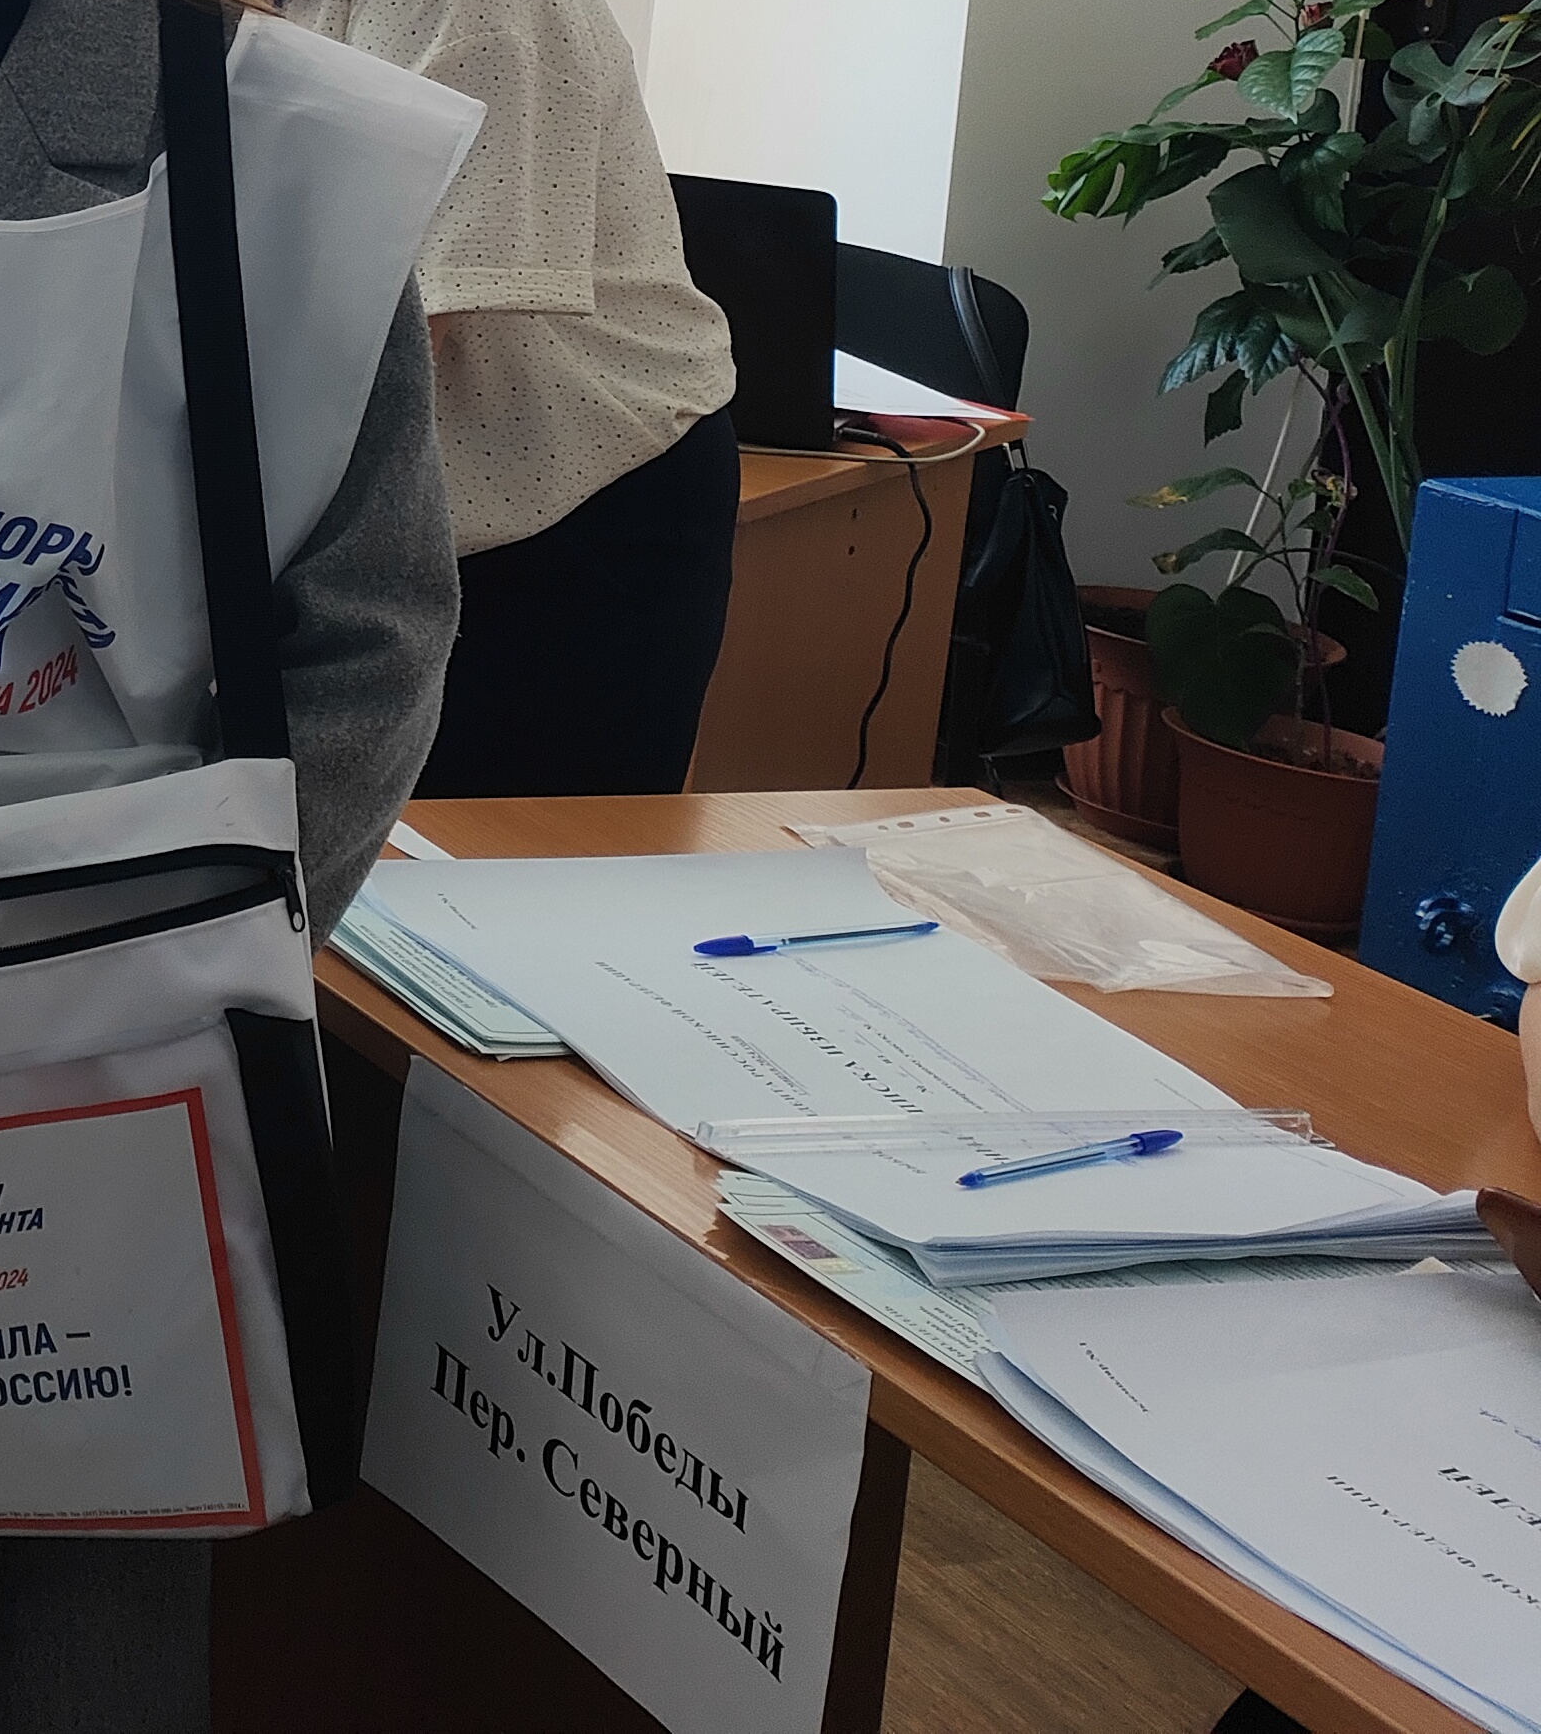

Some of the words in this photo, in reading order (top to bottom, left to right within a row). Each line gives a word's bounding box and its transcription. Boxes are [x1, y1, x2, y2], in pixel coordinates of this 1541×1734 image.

[17, 645, 80, 714] 2024
[845, 1061, 923, 1113] ПИСКА
[487, 1283, 750, 1535] Ул.Победы
[430, 1342, 526, 1464] Пер.
[542, 1438, 786, 1684] Северный
[1326, 1476, 1476, 1568] ФЕДЕРАЦИИ
